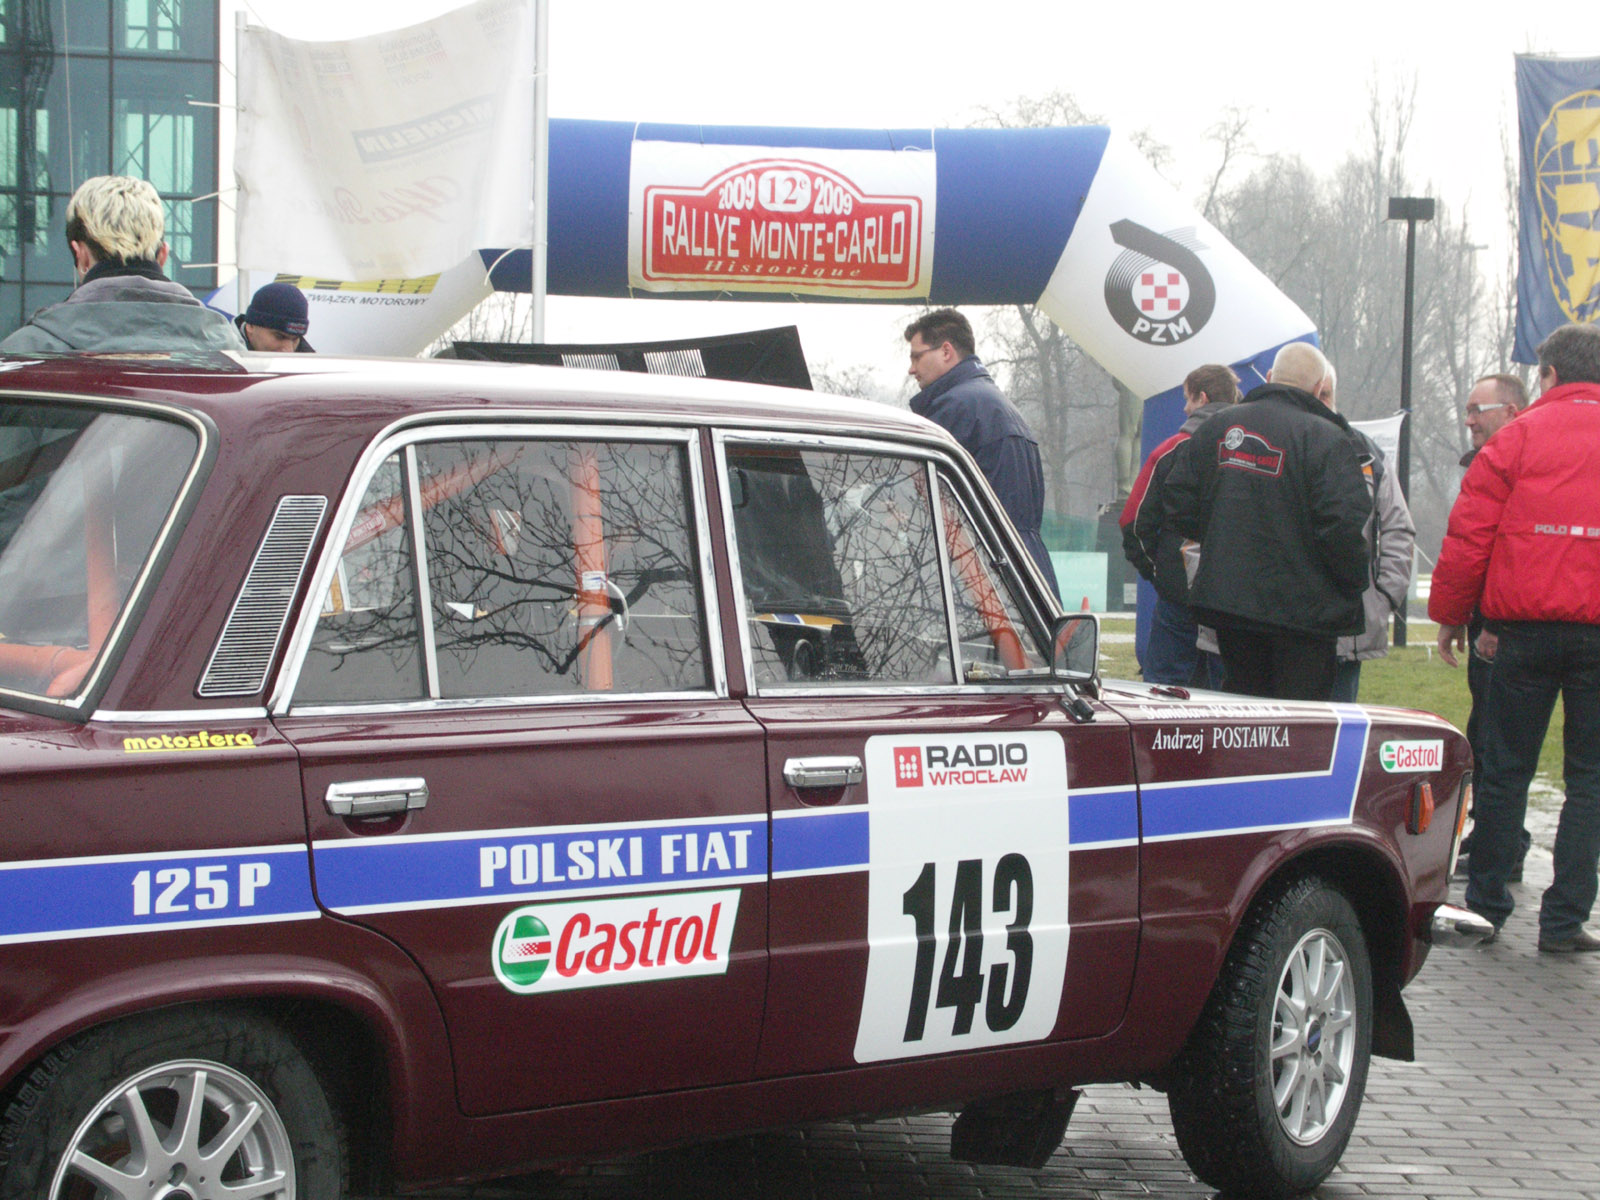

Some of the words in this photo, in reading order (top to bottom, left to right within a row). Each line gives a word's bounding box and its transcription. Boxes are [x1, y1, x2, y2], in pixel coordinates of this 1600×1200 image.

[719, 173, 756, 210] 2009
[813, 176, 852, 216] 2009
[662, 200, 740, 258] RALLYE
[750, 210, 905, 264] MONTE-CARLO
[704, 260, 861, 278] Historique
[359, 296, 428, 306] MOTOROWY
[1131, 316, 1193, 343] PZM
[1535, 524, 1568, 535] POLO
[123, 731, 254, 751] motosfera
[1151, 727, 1204, 754] Andrzej
[1212, 726, 1290, 748] POSTAWKA
[926, 743, 1028, 768] RADIO
[1397, 744, 1439, 768] Castrol
[928, 768, 1028, 785] WROCŁAW
[480, 836, 643, 888] POLSKI
[660, 830, 752, 875] FIAT
[555, 902, 722, 977] Castrol
[903, 853, 1033, 1042] 143
